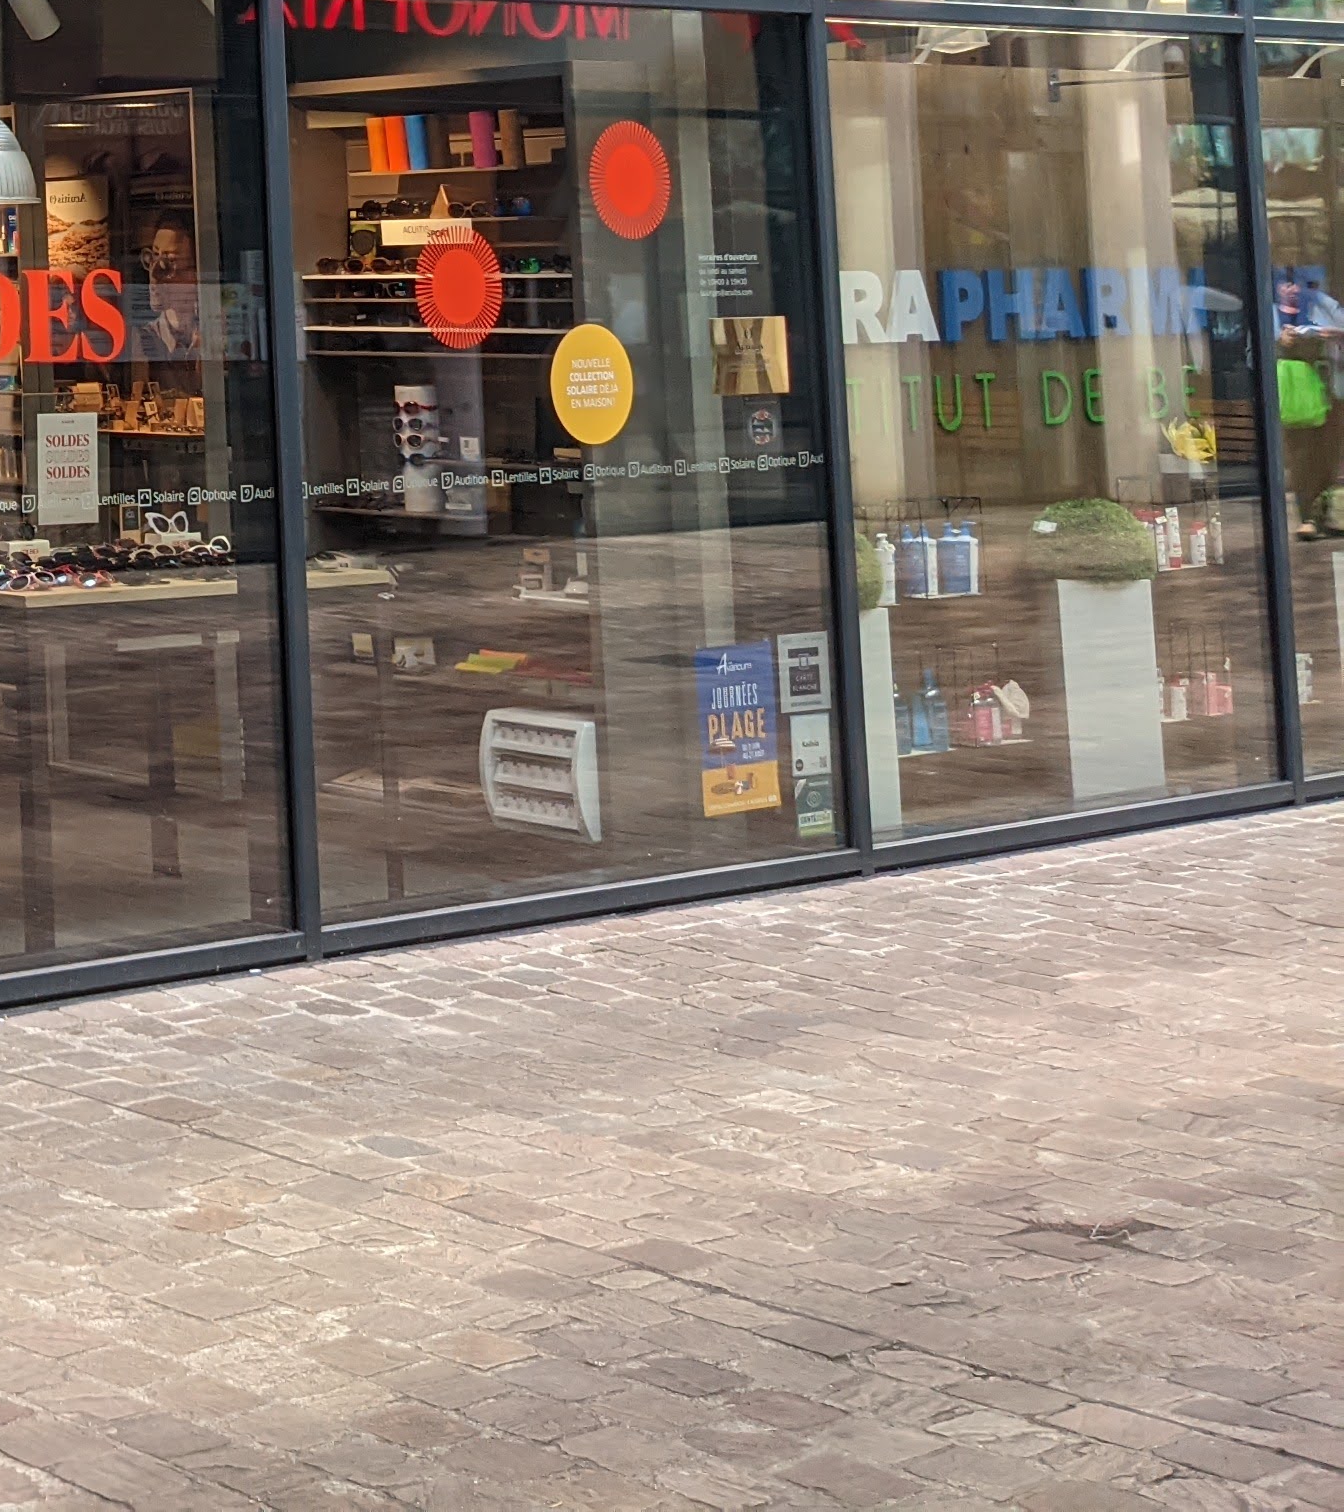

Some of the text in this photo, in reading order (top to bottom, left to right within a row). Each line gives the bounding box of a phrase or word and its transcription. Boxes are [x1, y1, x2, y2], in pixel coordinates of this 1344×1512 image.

[571, 358, 611, 369] NOUVELLE
[569, 370, 614, 382] COLLECTION
[566, 385, 598, 395] SOLAIRE
[571, 398, 582, 409] EN
[45, 433, 90, 448] SOLDES
[46, 465, 91, 479] SOLDES
[308, 482, 345, 497] Lentilles
[360, 479, 390, 493] Solaire
[454, 473, 489, 487] Audition
[97, 492, 136, 506] Lentilles
[153, 490, 186, 504] Solaire
[201, 487, 237, 503] Optique
[711, 681, 758, 710] JOURNÉES
[707, 707, 767, 745] PLAGE
